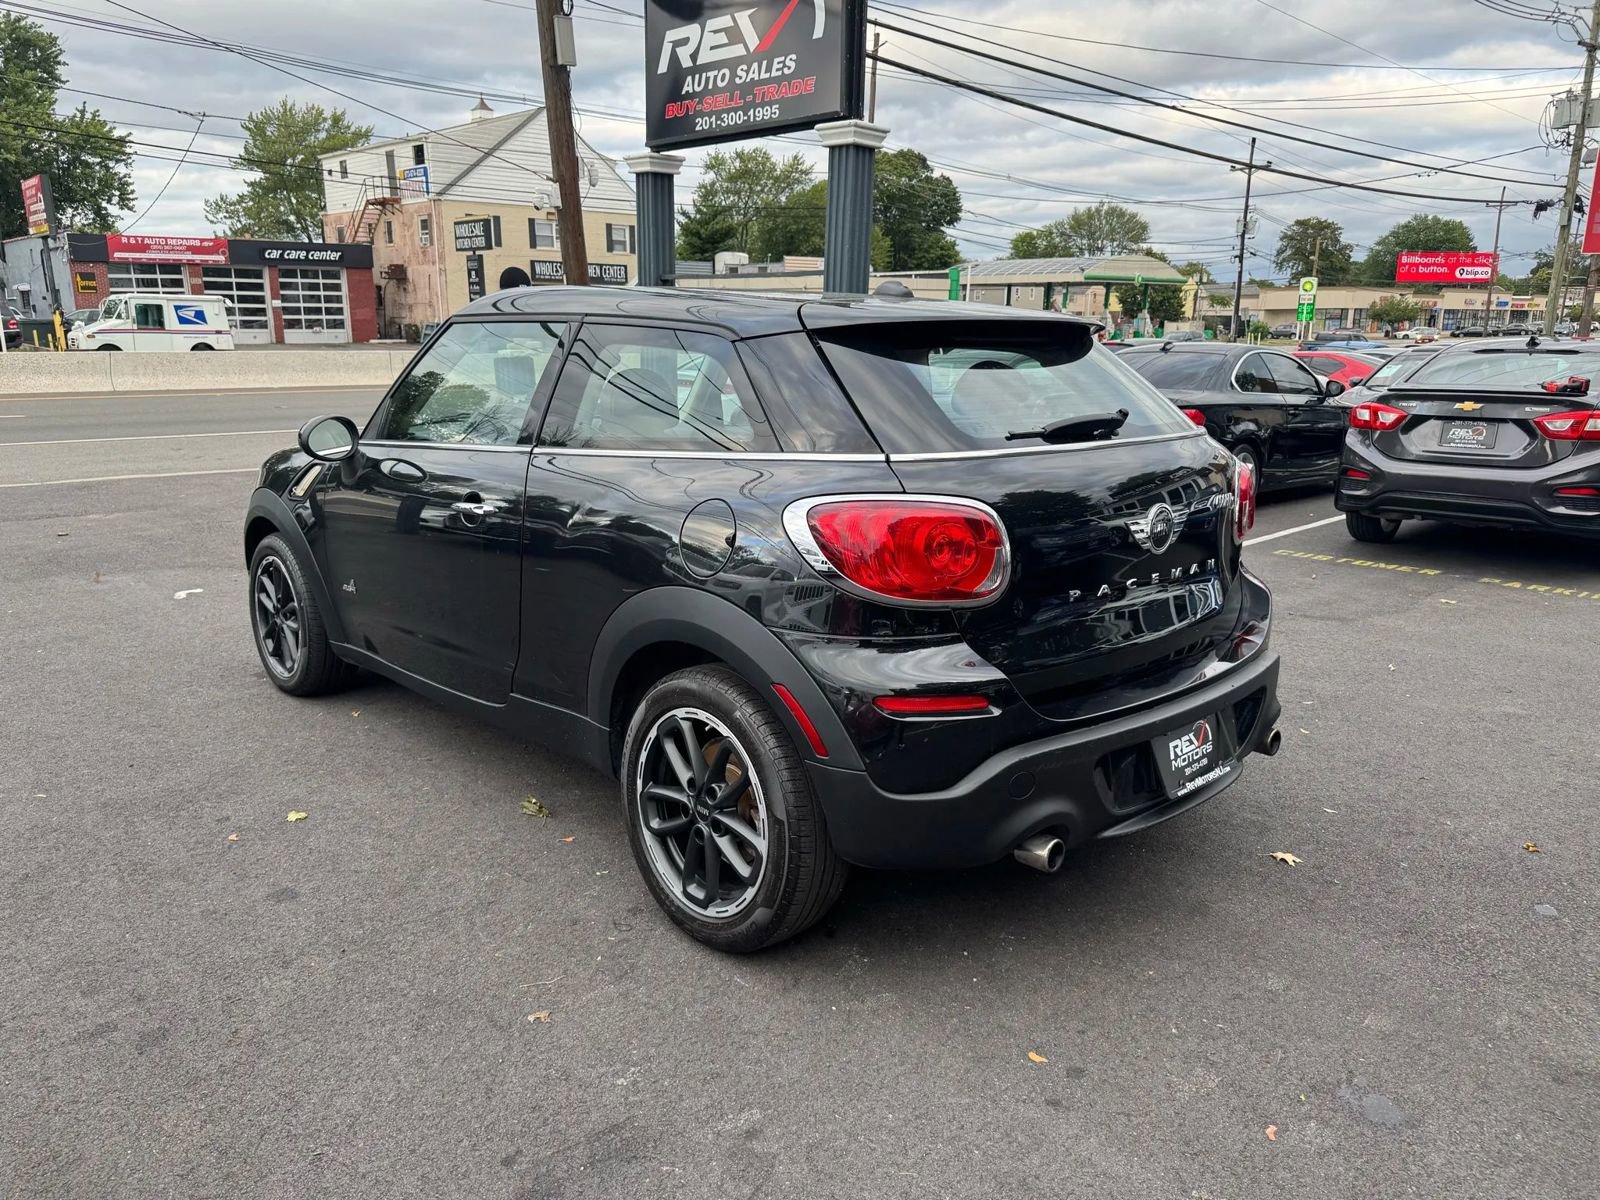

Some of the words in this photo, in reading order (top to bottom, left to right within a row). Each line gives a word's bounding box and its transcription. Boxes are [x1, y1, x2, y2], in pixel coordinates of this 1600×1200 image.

[681, 66, 730, 95] AUTO
[735, 54, 797, 84] SALES
[695, 105, 780, 131] 201-300-1995
[455, 221, 485, 238] WHOLESALE
[121, 236, 128, 244] R
[137, 237, 143, 245] T
[144, 237, 166, 246] AUTO
[167, 238, 201, 247] REPAIRS
[456, 237, 471, 249] KITCHEN
[471, 236, 486, 248] CENTER
[264, 249, 282, 260] car
[284, 249, 307, 260] care
[308, 249, 342, 261] center
[1401, 255, 1445, 264] Billboards
[1459, 256, 1473, 264] the
[602, 265, 626, 279] CENTER
[1399, 265, 1409, 273] of
[1418, 265, 1450, 273] button.
[1465, 268, 1489, 277] blip.co
[1272, 548, 1442, 576] CUSTOMER
[1068, 557, 1217, 603] PACEMAN
[1172, 741, 1213, 771] MOTORS
